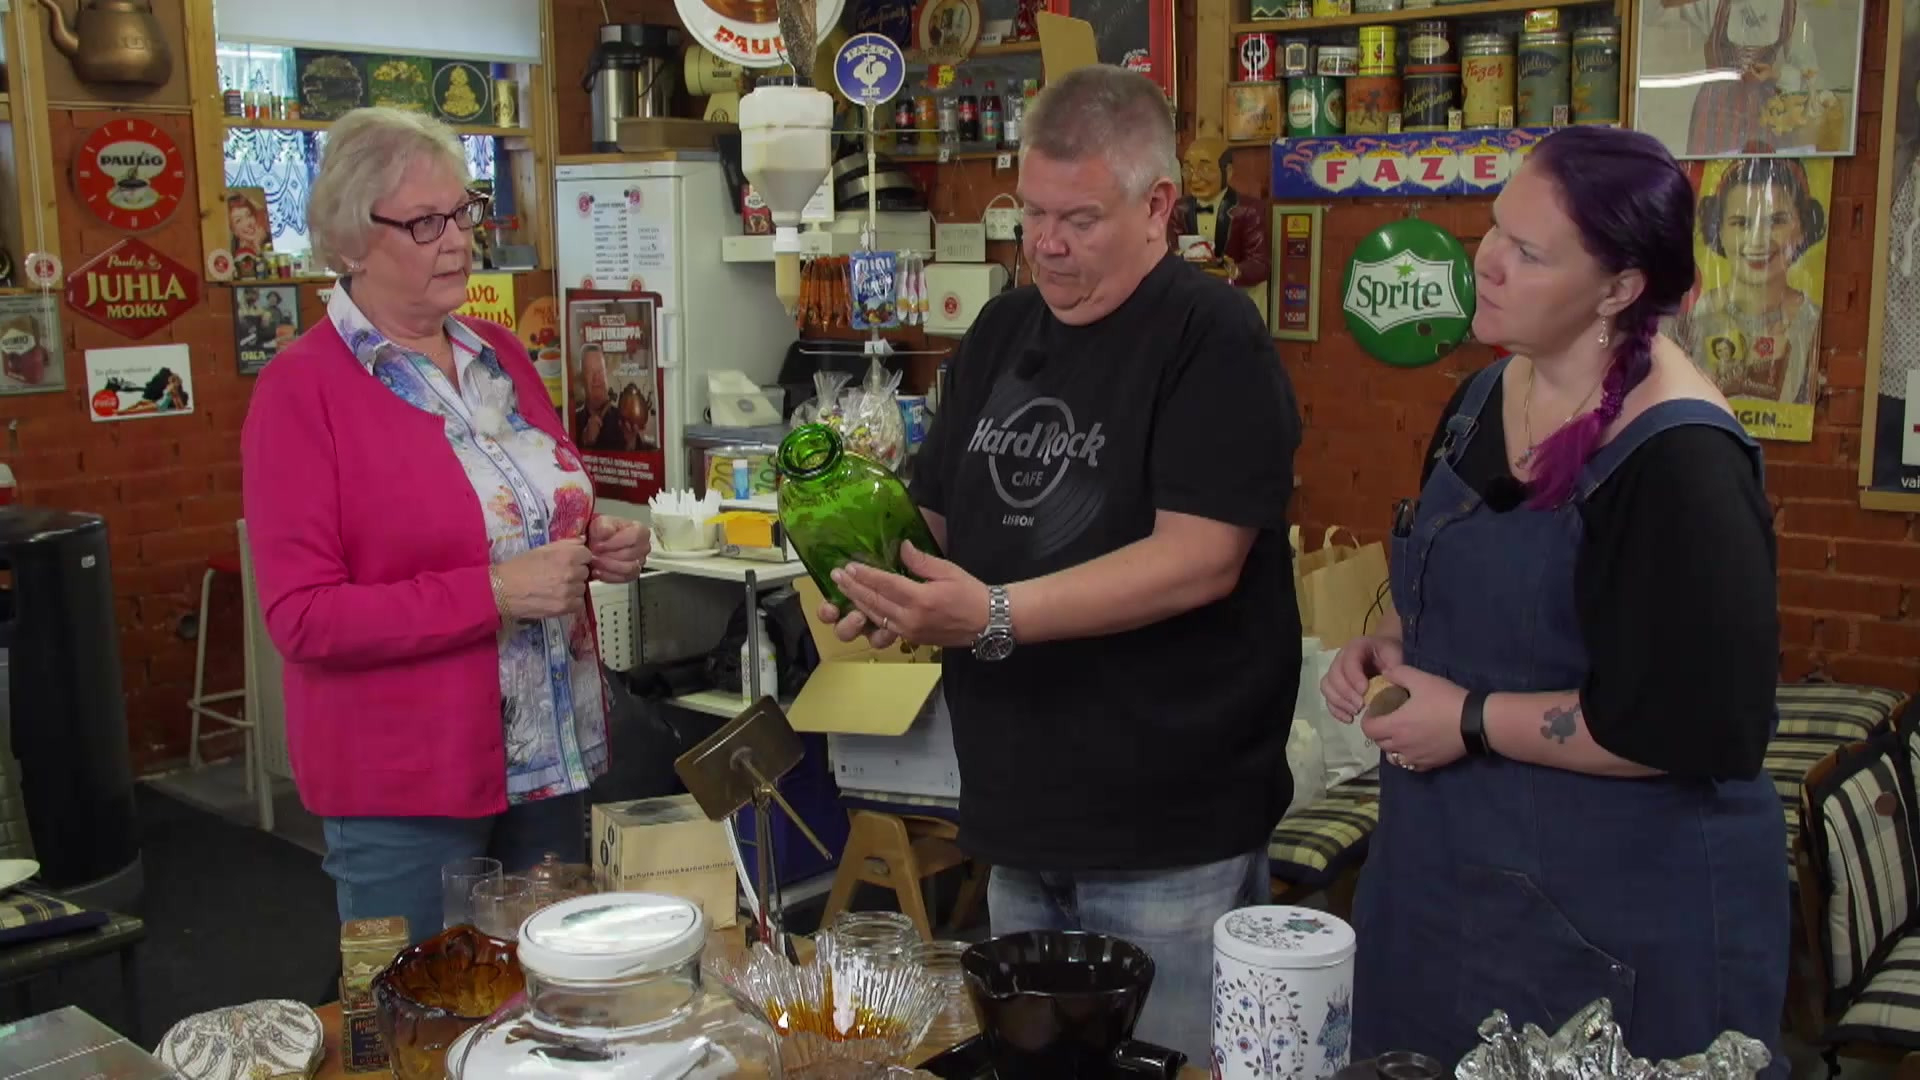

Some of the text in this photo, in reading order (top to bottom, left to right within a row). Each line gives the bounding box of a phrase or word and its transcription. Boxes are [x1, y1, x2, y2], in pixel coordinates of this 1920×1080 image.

[1465, 60, 1505, 83] Fazer
[1326, 155, 1497, 185] FAZE
[85, 272, 187, 307] JUHLA
[1356, 275, 1444, 318] Sprite
[107, 304, 167, 319] MOKKA
[968, 417, 1106, 467] Hard Rock
[1011, 471, 1044, 487] CAFE
[1002, 514, 1035, 526] LISBON
